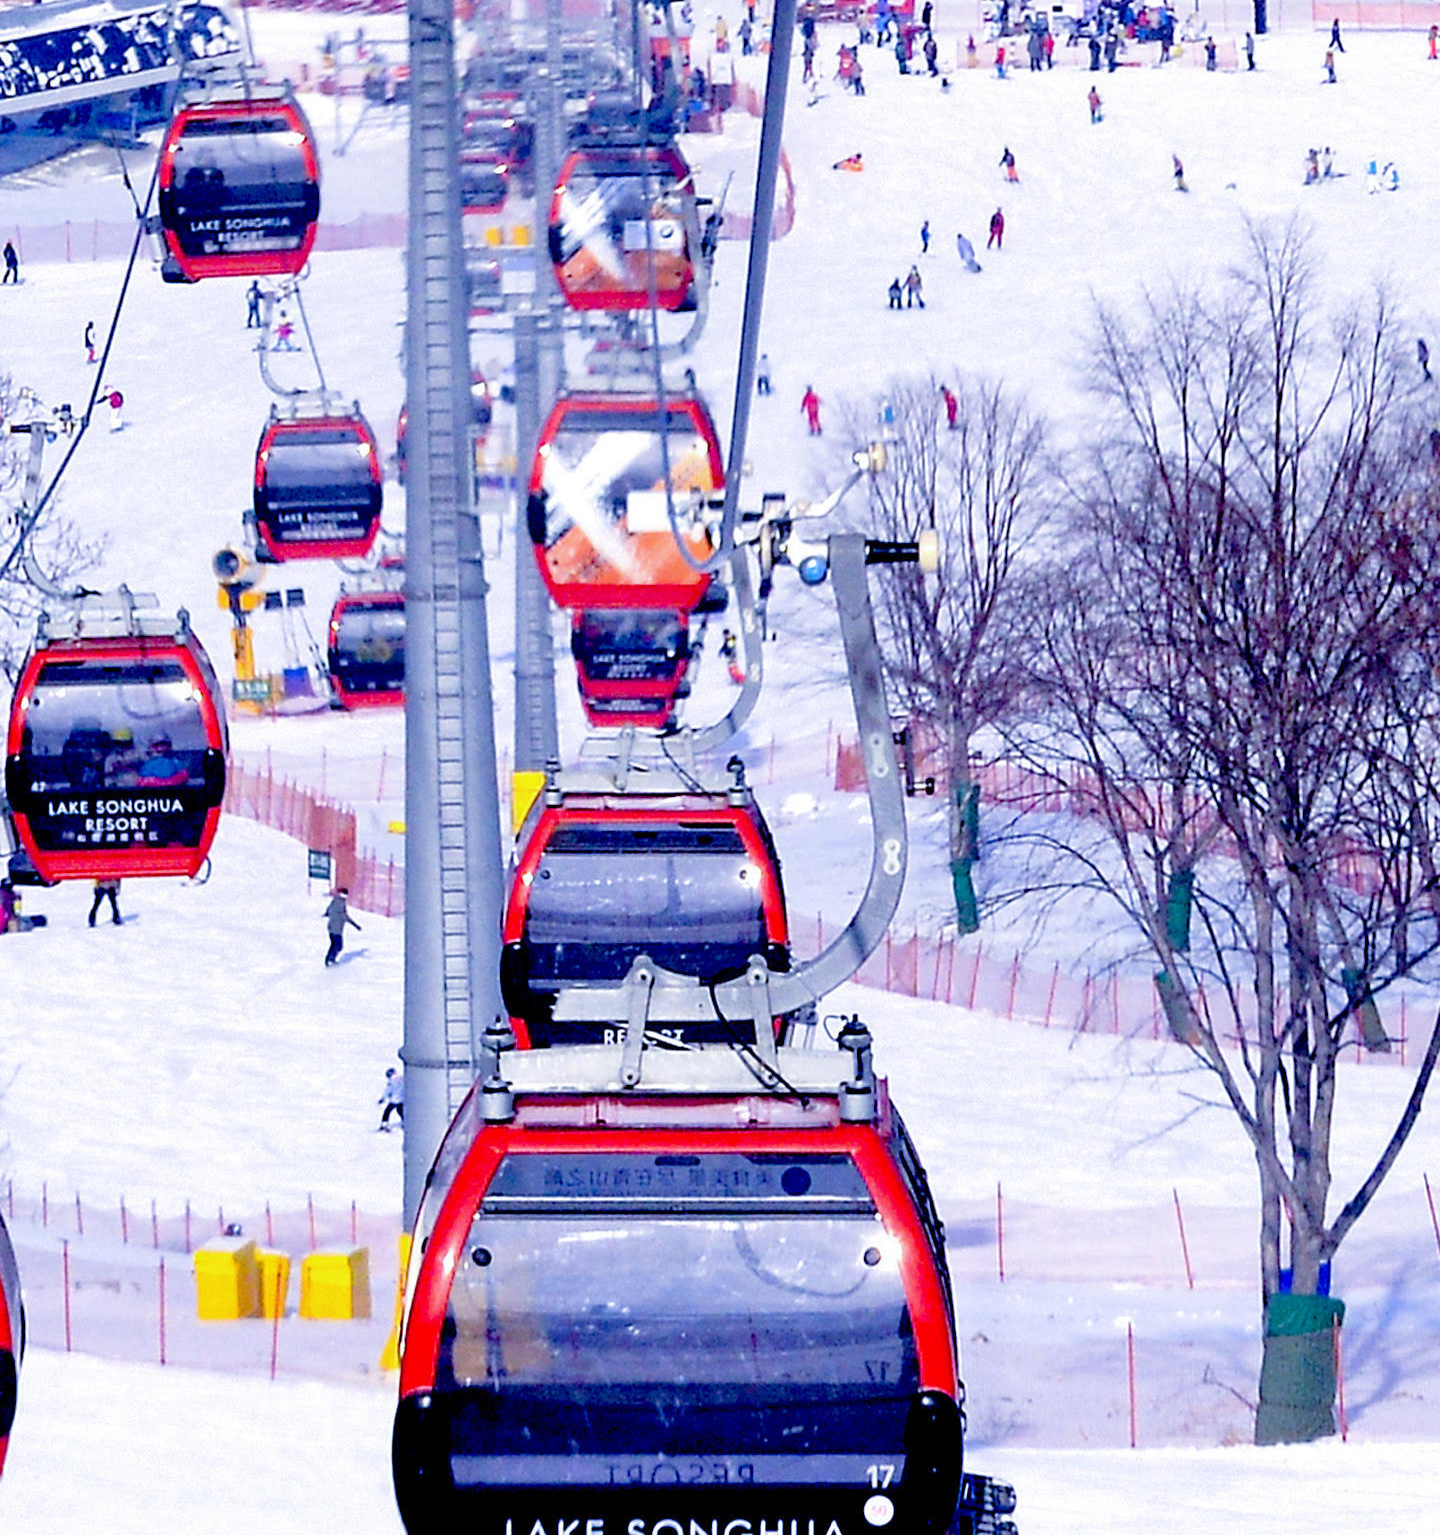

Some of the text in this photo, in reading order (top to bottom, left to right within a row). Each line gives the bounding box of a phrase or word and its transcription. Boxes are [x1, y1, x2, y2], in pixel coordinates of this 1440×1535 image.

[48, 798, 184, 816] LAKE SONGHUA
[85, 817, 148, 832] RESORT
[866, 1464, 895, 1489] 17
